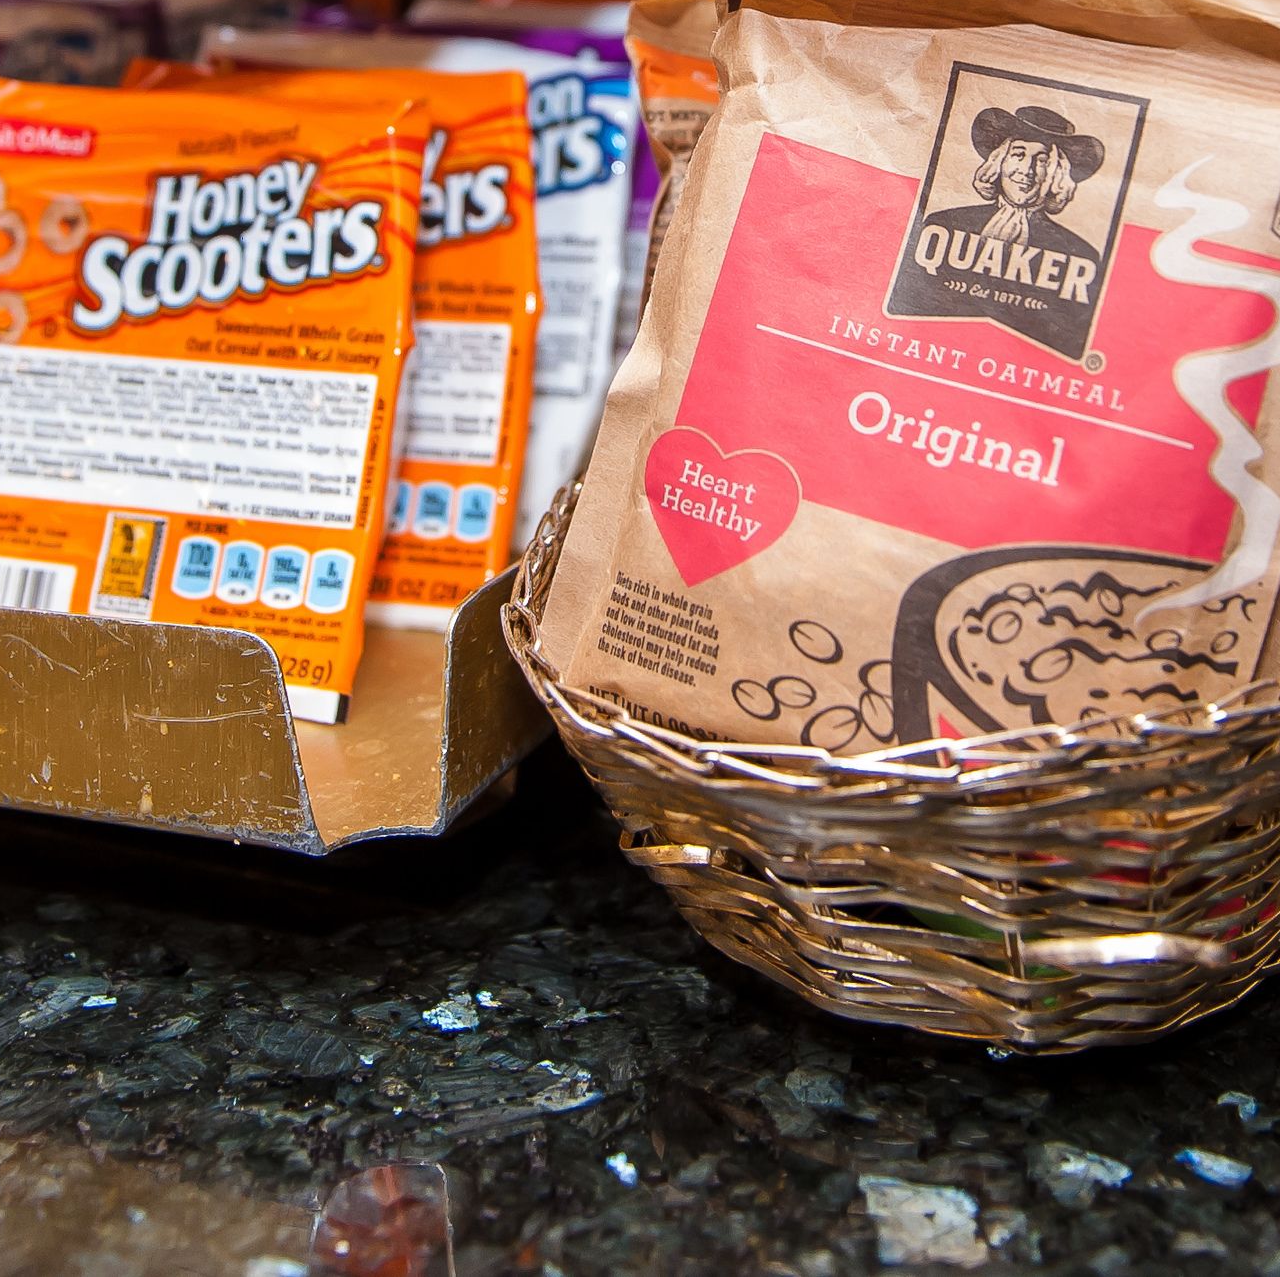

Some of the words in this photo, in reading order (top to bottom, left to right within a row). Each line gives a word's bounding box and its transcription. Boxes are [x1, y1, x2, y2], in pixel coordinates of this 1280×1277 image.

[149, 160, 318, 245] Honey
[73, 201, 382, 330] Scooters
[914, 224, 1097, 305] QUAKER
[969, 284, 991, 299] Est
[994, 290, 1022, 307] 1877
[829, 315, 968, 370] INSTANT
[978, 357, 1126, 412] OATMEAL
[847, 391, 1066, 487] Original
[679, 459, 757, 505] Heart
[661, 484, 762, 542] Healthy
[610, 586, 631, 608] foods
[631, 600, 647, 614] and
[647, 605, 670, 622] other
[670, 612, 694, 633] plant
[694, 620, 720, 641] foods
[633, 580, 650, 598] rich
[651, 585, 661, 601] in
[662, 592, 689, 612] whole
[689, 603, 713, 621] grain
[601, 621, 646, 650] cholesterol
[646, 640, 664, 660] may
[664, 644, 685, 667] help
[685, 654, 718, 677] reduce
[605, 606, 621, 621] and
[621, 610, 636, 628] low
[636, 615, 646, 633] in
[646, 623, 688, 647] saturated
[688, 635, 702, 652] fat
[701, 643, 720, 660] and
[597, 636, 610, 653] the
[610, 644, 626, 661] risk
[627, 649, 638, 664] of
[638, 652, 661, 674] heart
[660, 662, 697, 688] disease.
